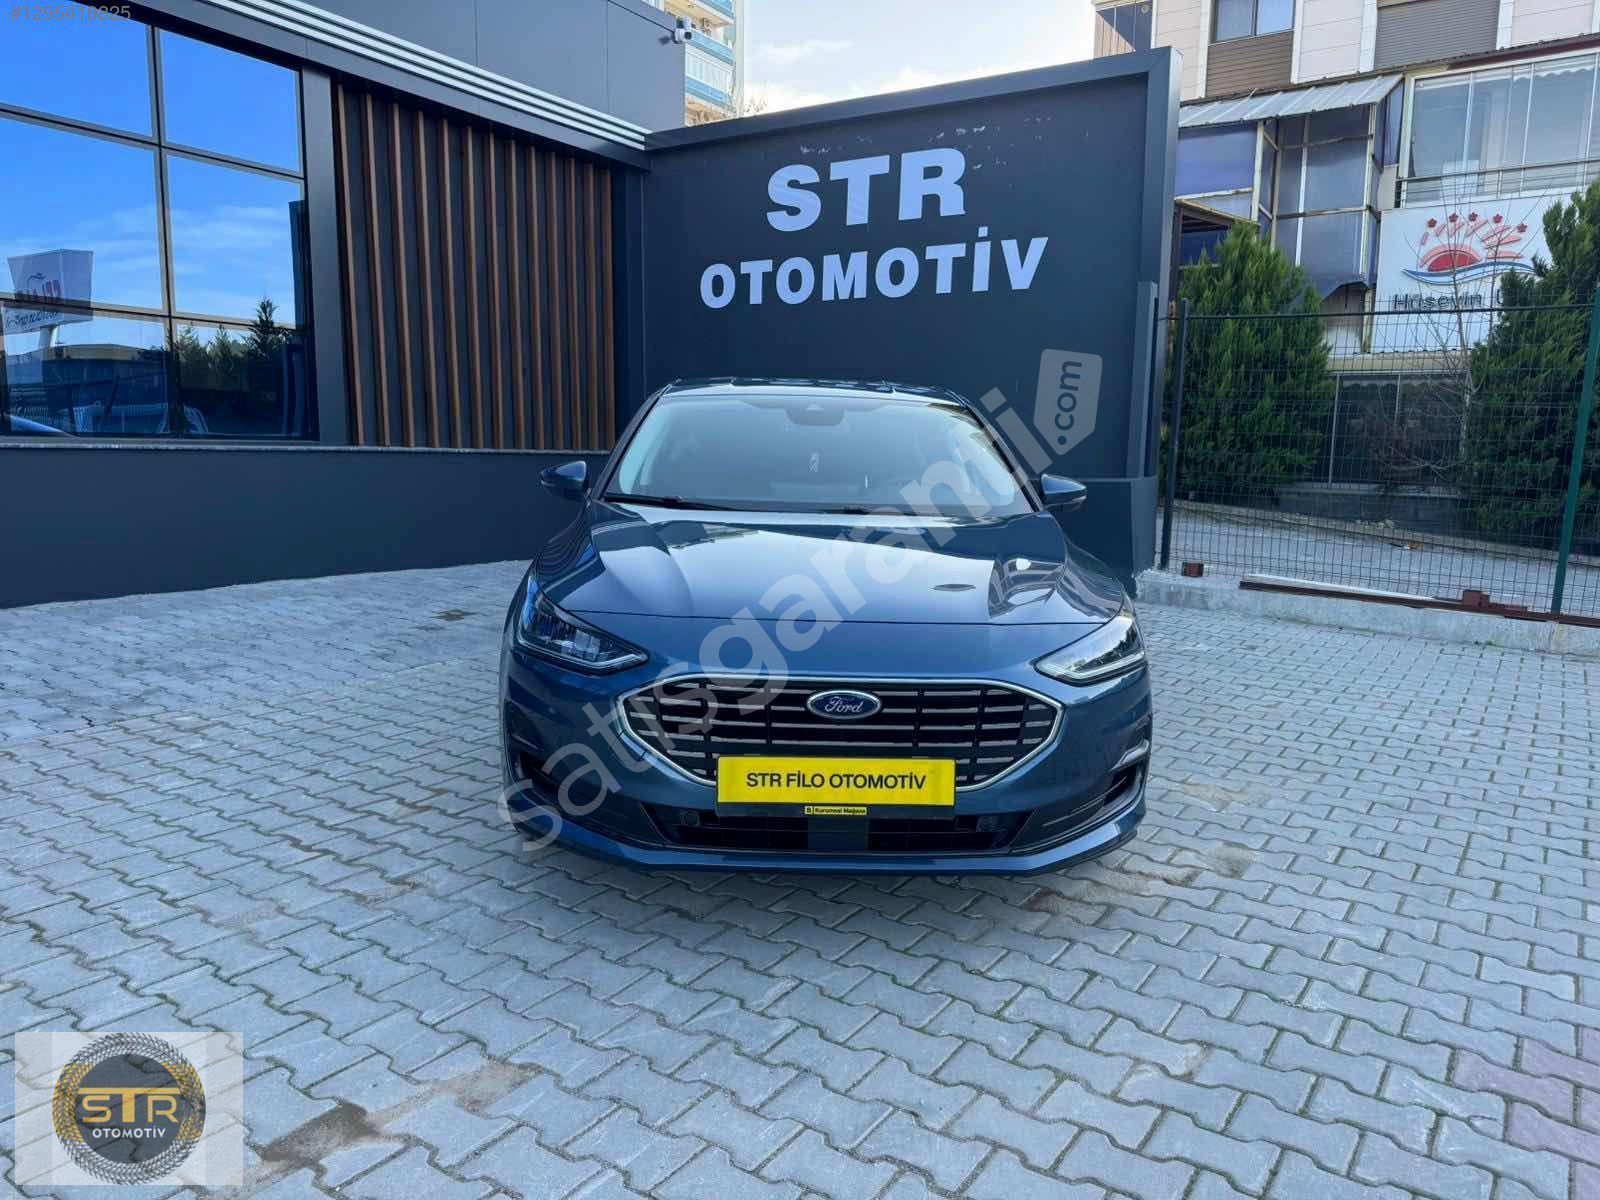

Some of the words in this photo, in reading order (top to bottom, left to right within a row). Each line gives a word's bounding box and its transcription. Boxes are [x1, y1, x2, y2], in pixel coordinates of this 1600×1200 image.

[766, 148, 966, 232] STR
[700, 226, 1049, 309] OTOMOTİV
[824, 696, 864, 713] Ford
[746, 772, 781, 788] STR
[786, 770, 825, 789] FİLO
[829, 772, 926, 790] OTOMOTİV
